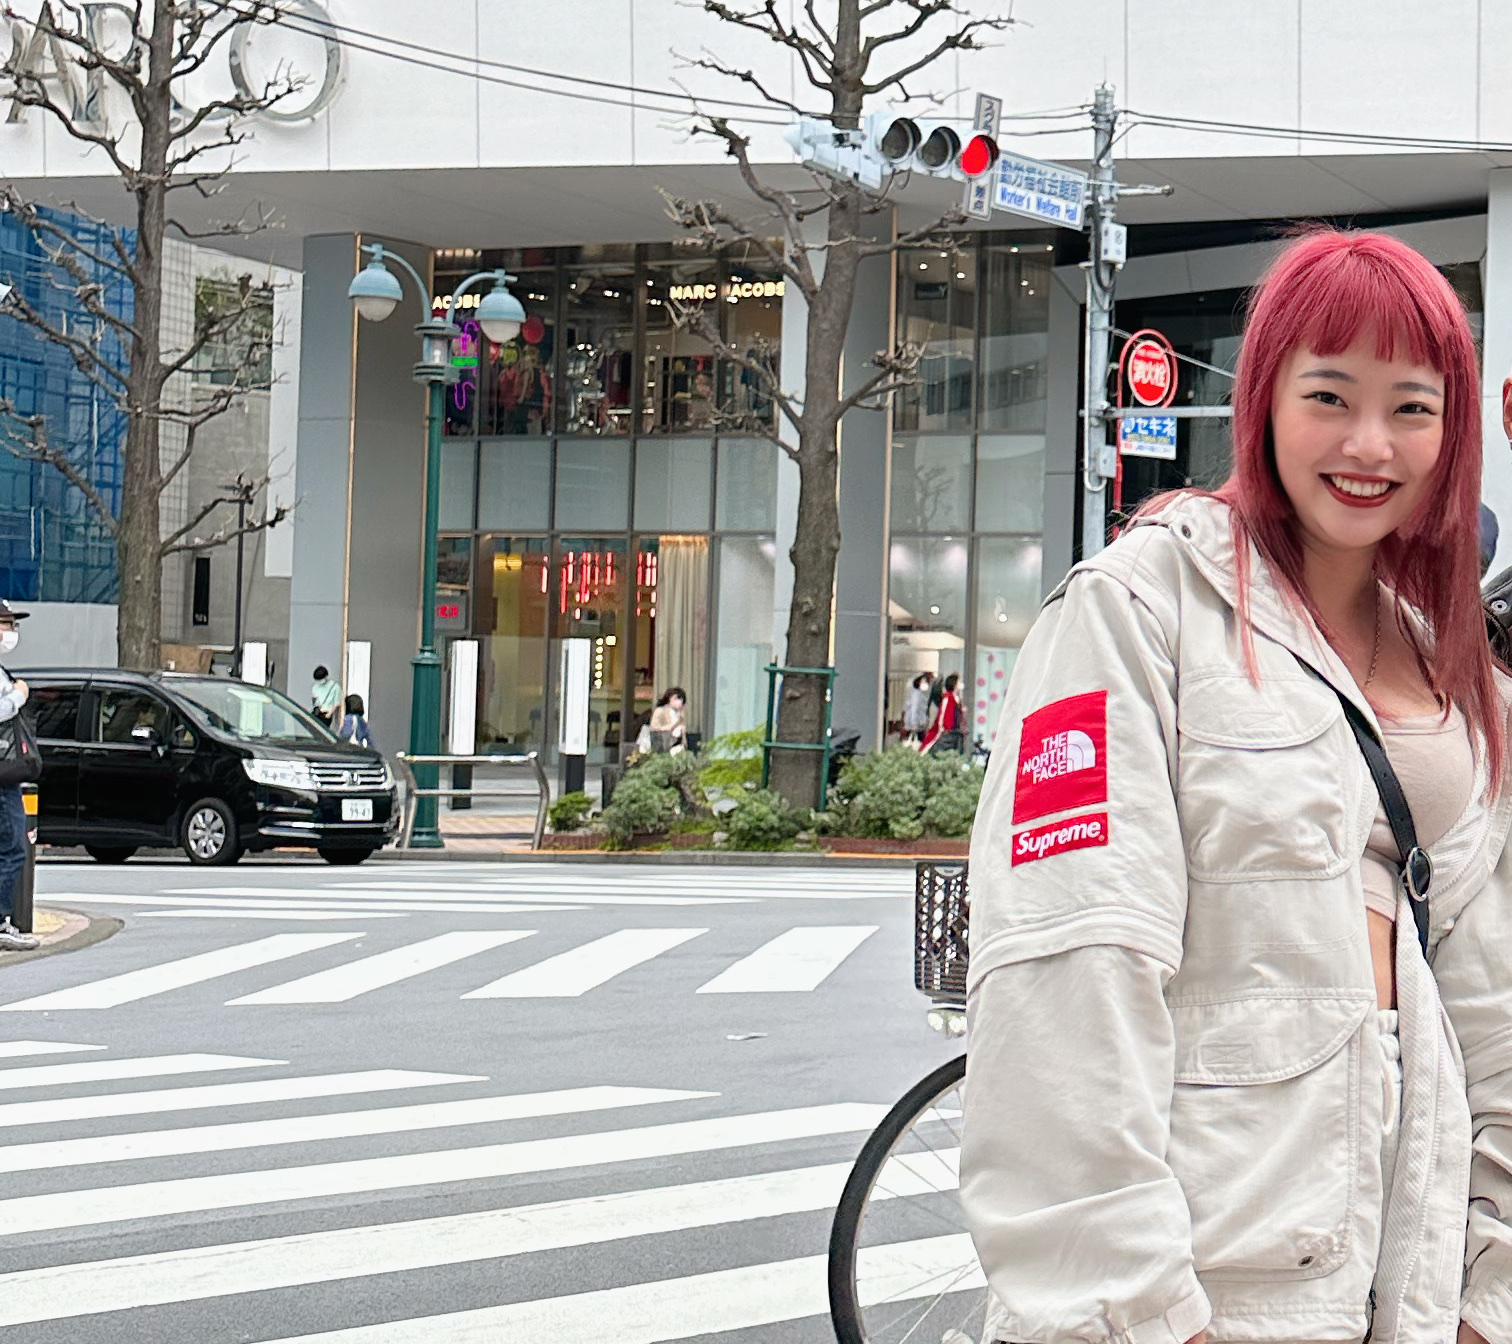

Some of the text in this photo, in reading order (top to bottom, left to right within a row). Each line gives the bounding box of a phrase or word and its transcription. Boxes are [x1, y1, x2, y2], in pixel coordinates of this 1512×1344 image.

[669, 284, 716, 300] MARC
[1041, 731, 1068, 753] THE
[1021, 745, 1068, 775] NORTH
[1032, 760, 1068, 785] FACE
[1016, 821, 1102, 858] Supreme
